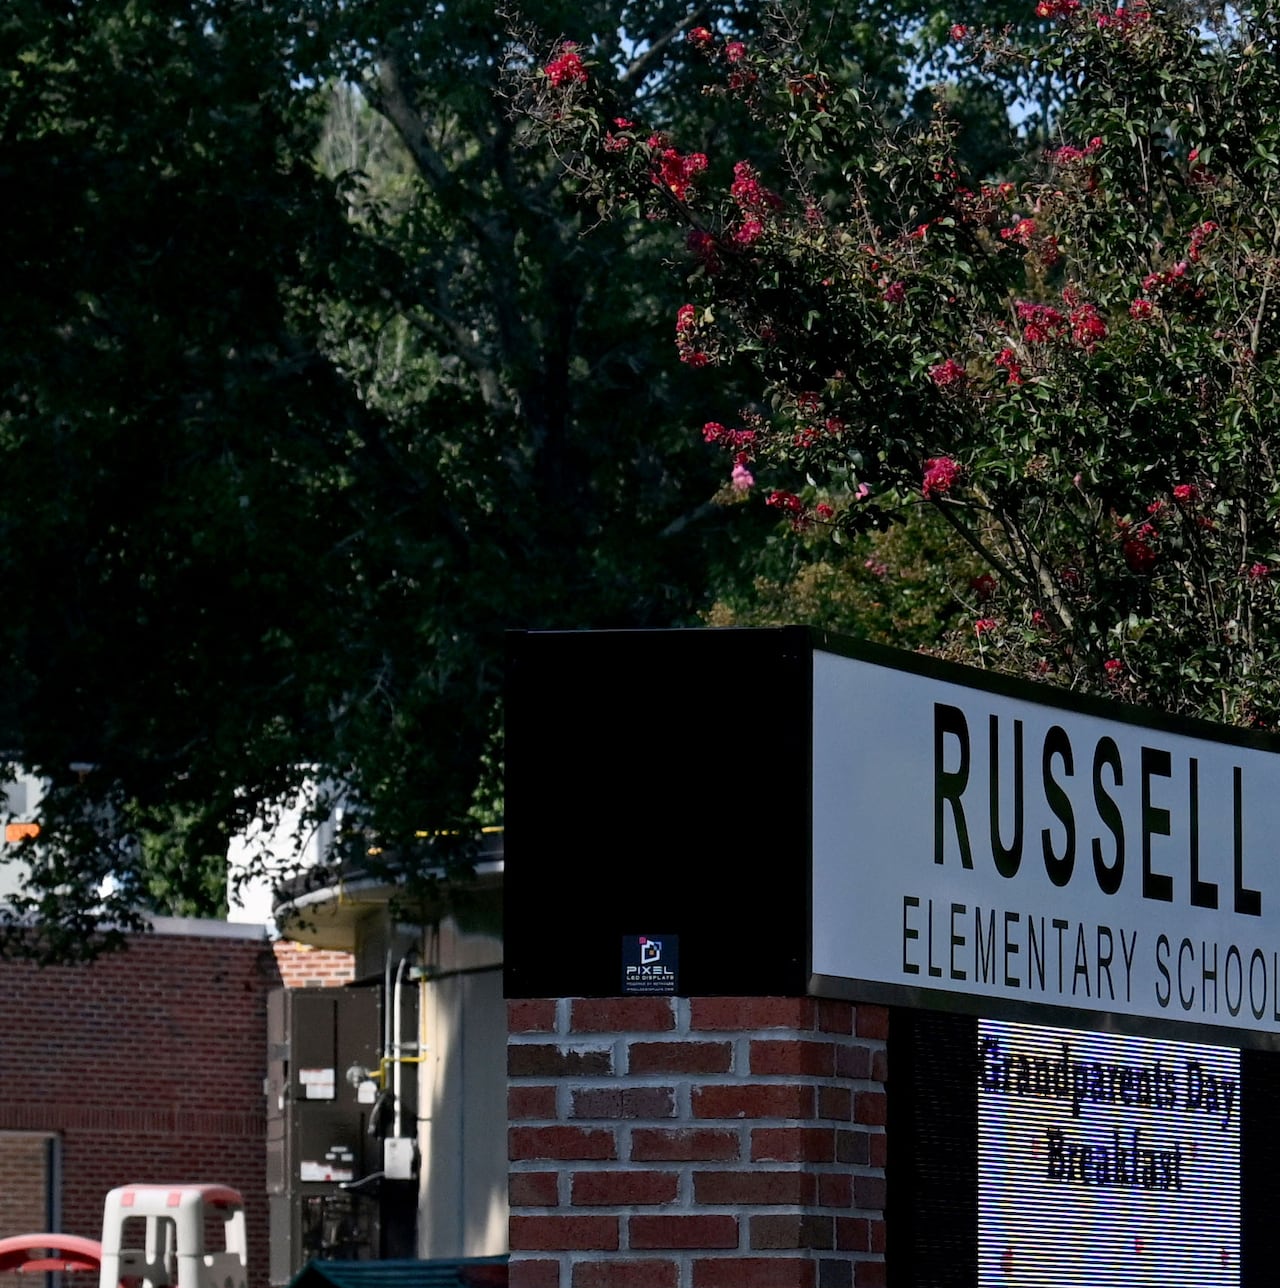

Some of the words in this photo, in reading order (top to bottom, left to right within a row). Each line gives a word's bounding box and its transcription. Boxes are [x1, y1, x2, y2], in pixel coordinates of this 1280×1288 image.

[934, 702, 1262, 917] RUSSELL
[626, 966, 674, 975] PIXEL
[903, 895, 1138, 1003] ELEMENTARY
[979, 1036, 1178, 1118] Grandparents
[1186, 1059, 1236, 1130] Day
[1046, 1126, 1183, 1190] Breakfast
